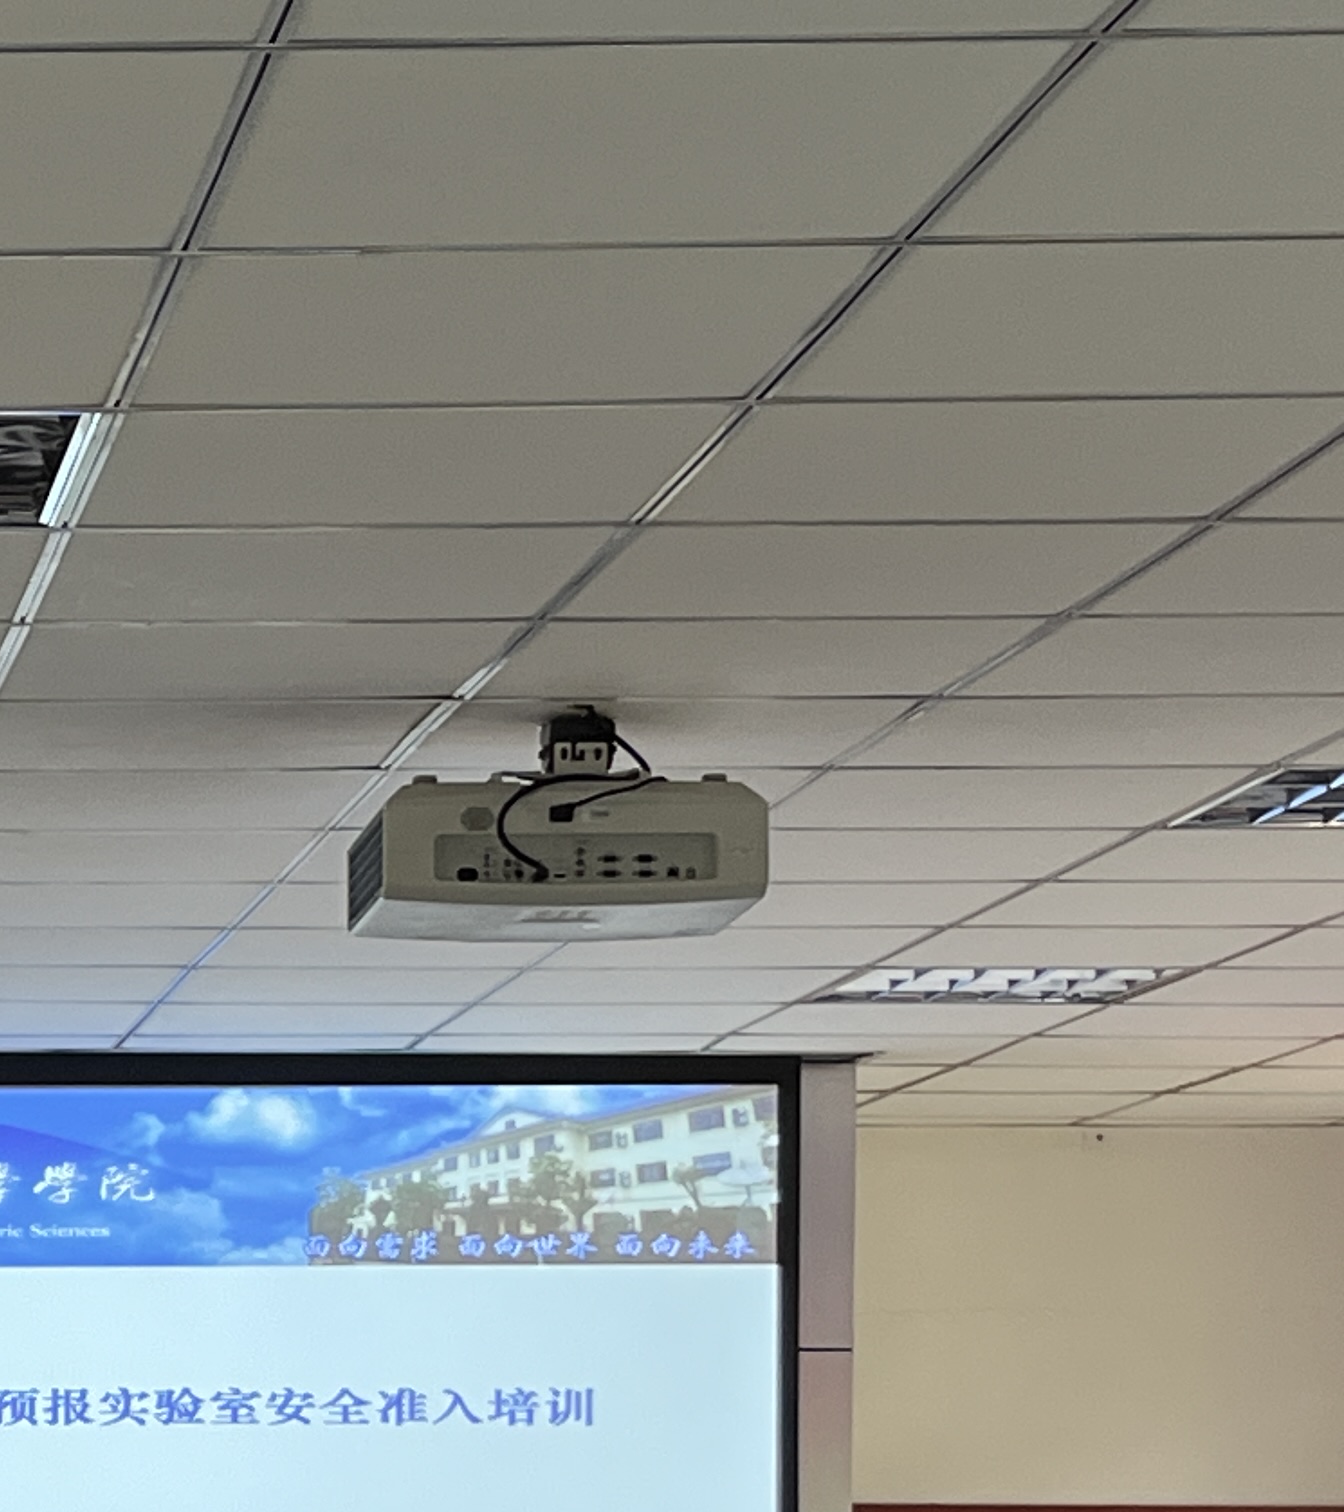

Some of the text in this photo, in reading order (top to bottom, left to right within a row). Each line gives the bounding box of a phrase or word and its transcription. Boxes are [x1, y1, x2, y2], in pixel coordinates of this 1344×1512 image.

[29, 1223, 111, 1240] Sciences
[303, 1230, 755, 1262] 面向需求 面向世界 面向未来
